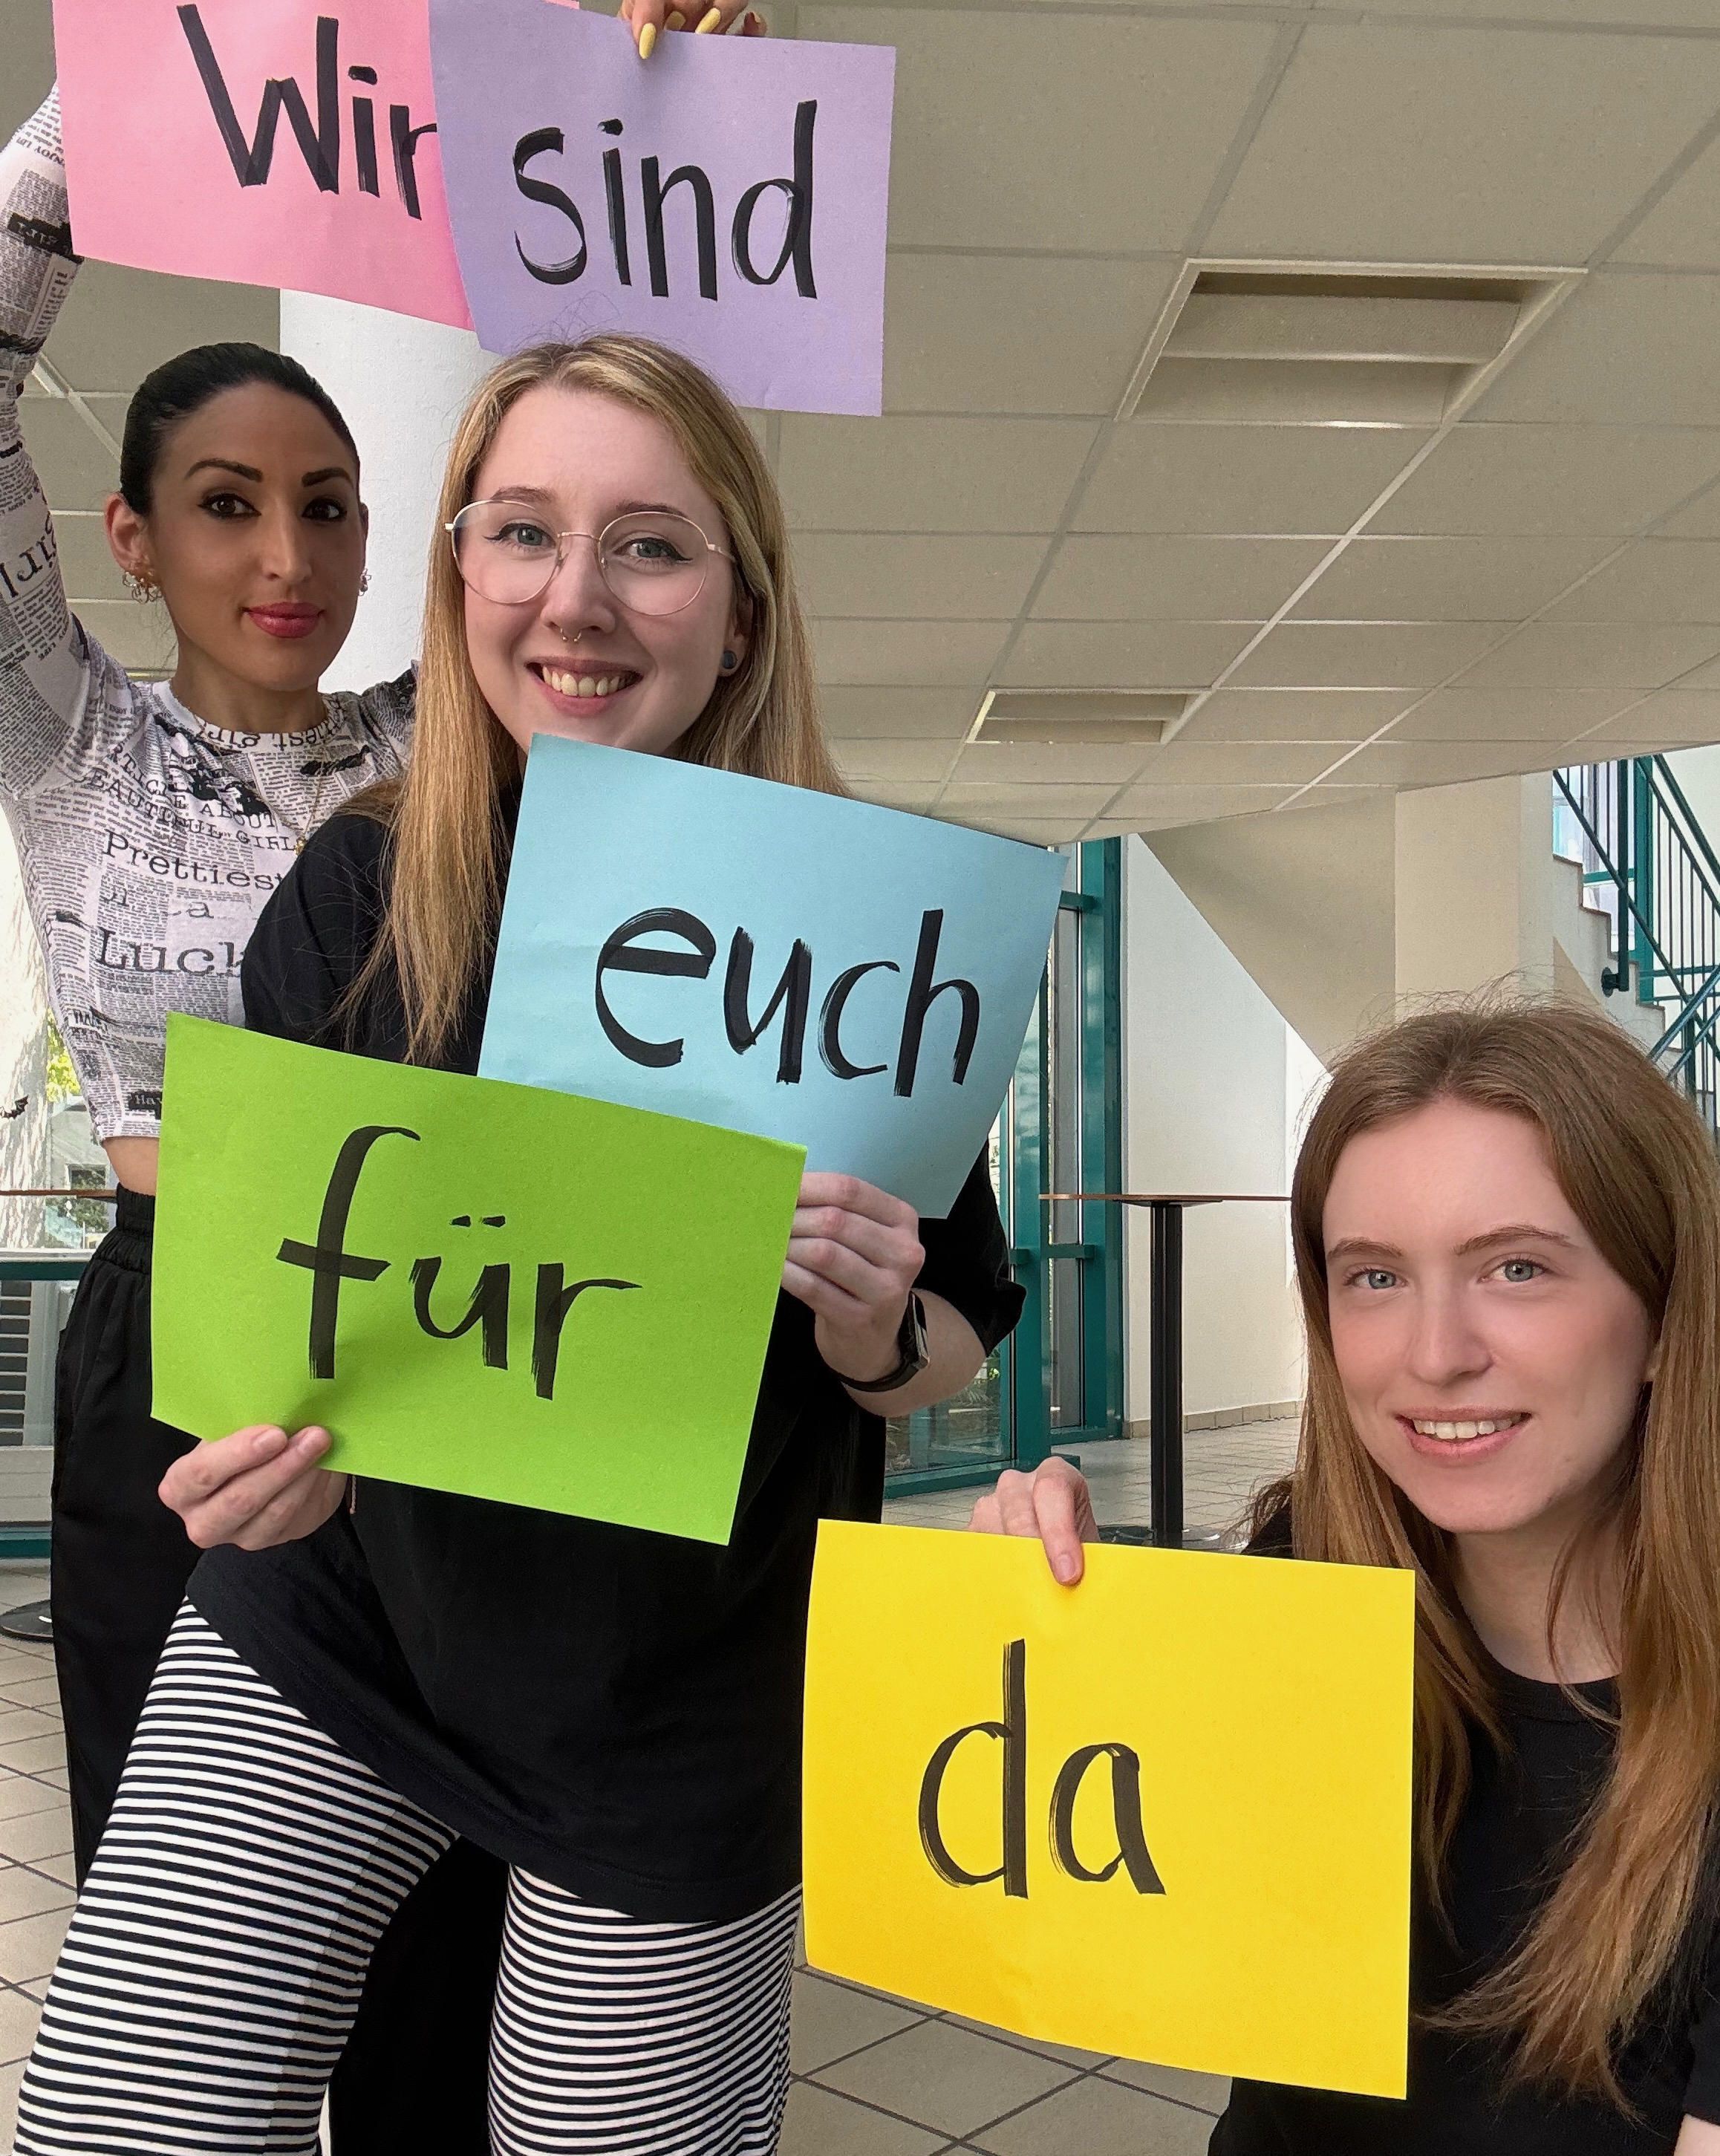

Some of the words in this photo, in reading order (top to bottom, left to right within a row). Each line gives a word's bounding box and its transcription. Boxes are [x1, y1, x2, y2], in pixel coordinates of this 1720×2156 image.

[176, 4, 438, 221] Wir
[512, 99, 818, 302] sind
[595, 907, 980, 1098] euch
[276, 1125, 643, 1401] für
[918, 1638, 1166, 1899] da
